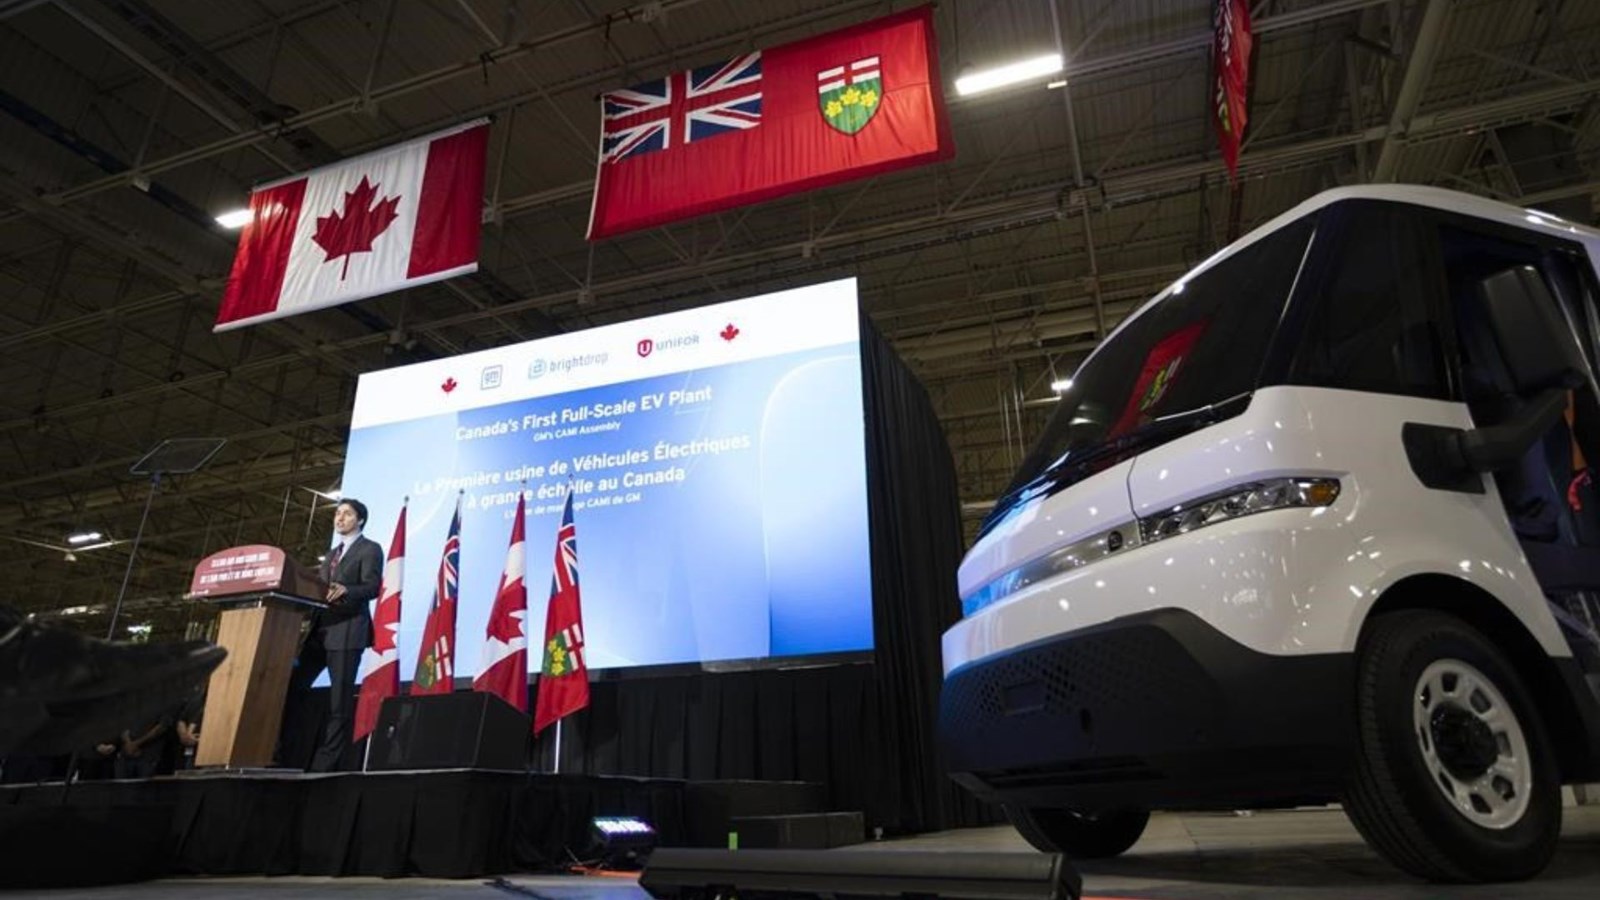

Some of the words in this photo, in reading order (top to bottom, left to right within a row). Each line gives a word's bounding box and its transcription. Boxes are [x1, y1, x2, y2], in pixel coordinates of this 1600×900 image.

[656, 335, 700, 351] UNIFOR
[549, 352, 609, 373] brightdrop
[456, 418, 519, 440] Canada's
[522, 411, 558, 431] First
[561, 399, 637, 423] Full-Scale
[641, 392, 665, 411] EV
[668, 385, 712, 407] Plant
[533, 431, 554, 442] GM's
[555, 427, 578, 439] CAMI
[579, 421, 621, 435] Assembly
[433, 471, 500, 492] Première
[505, 464, 545, 482] usine
[549, 461, 568, 476] de
[573, 449, 649, 472] Véhicules
[654, 435, 750, 461] Électriques
[537, 479, 594, 499] échlle
[598, 476, 618, 492] au
[623, 465, 685, 488] Canada
[587, 495, 611, 508] CAMI
[625, 492, 642, 503] GM
